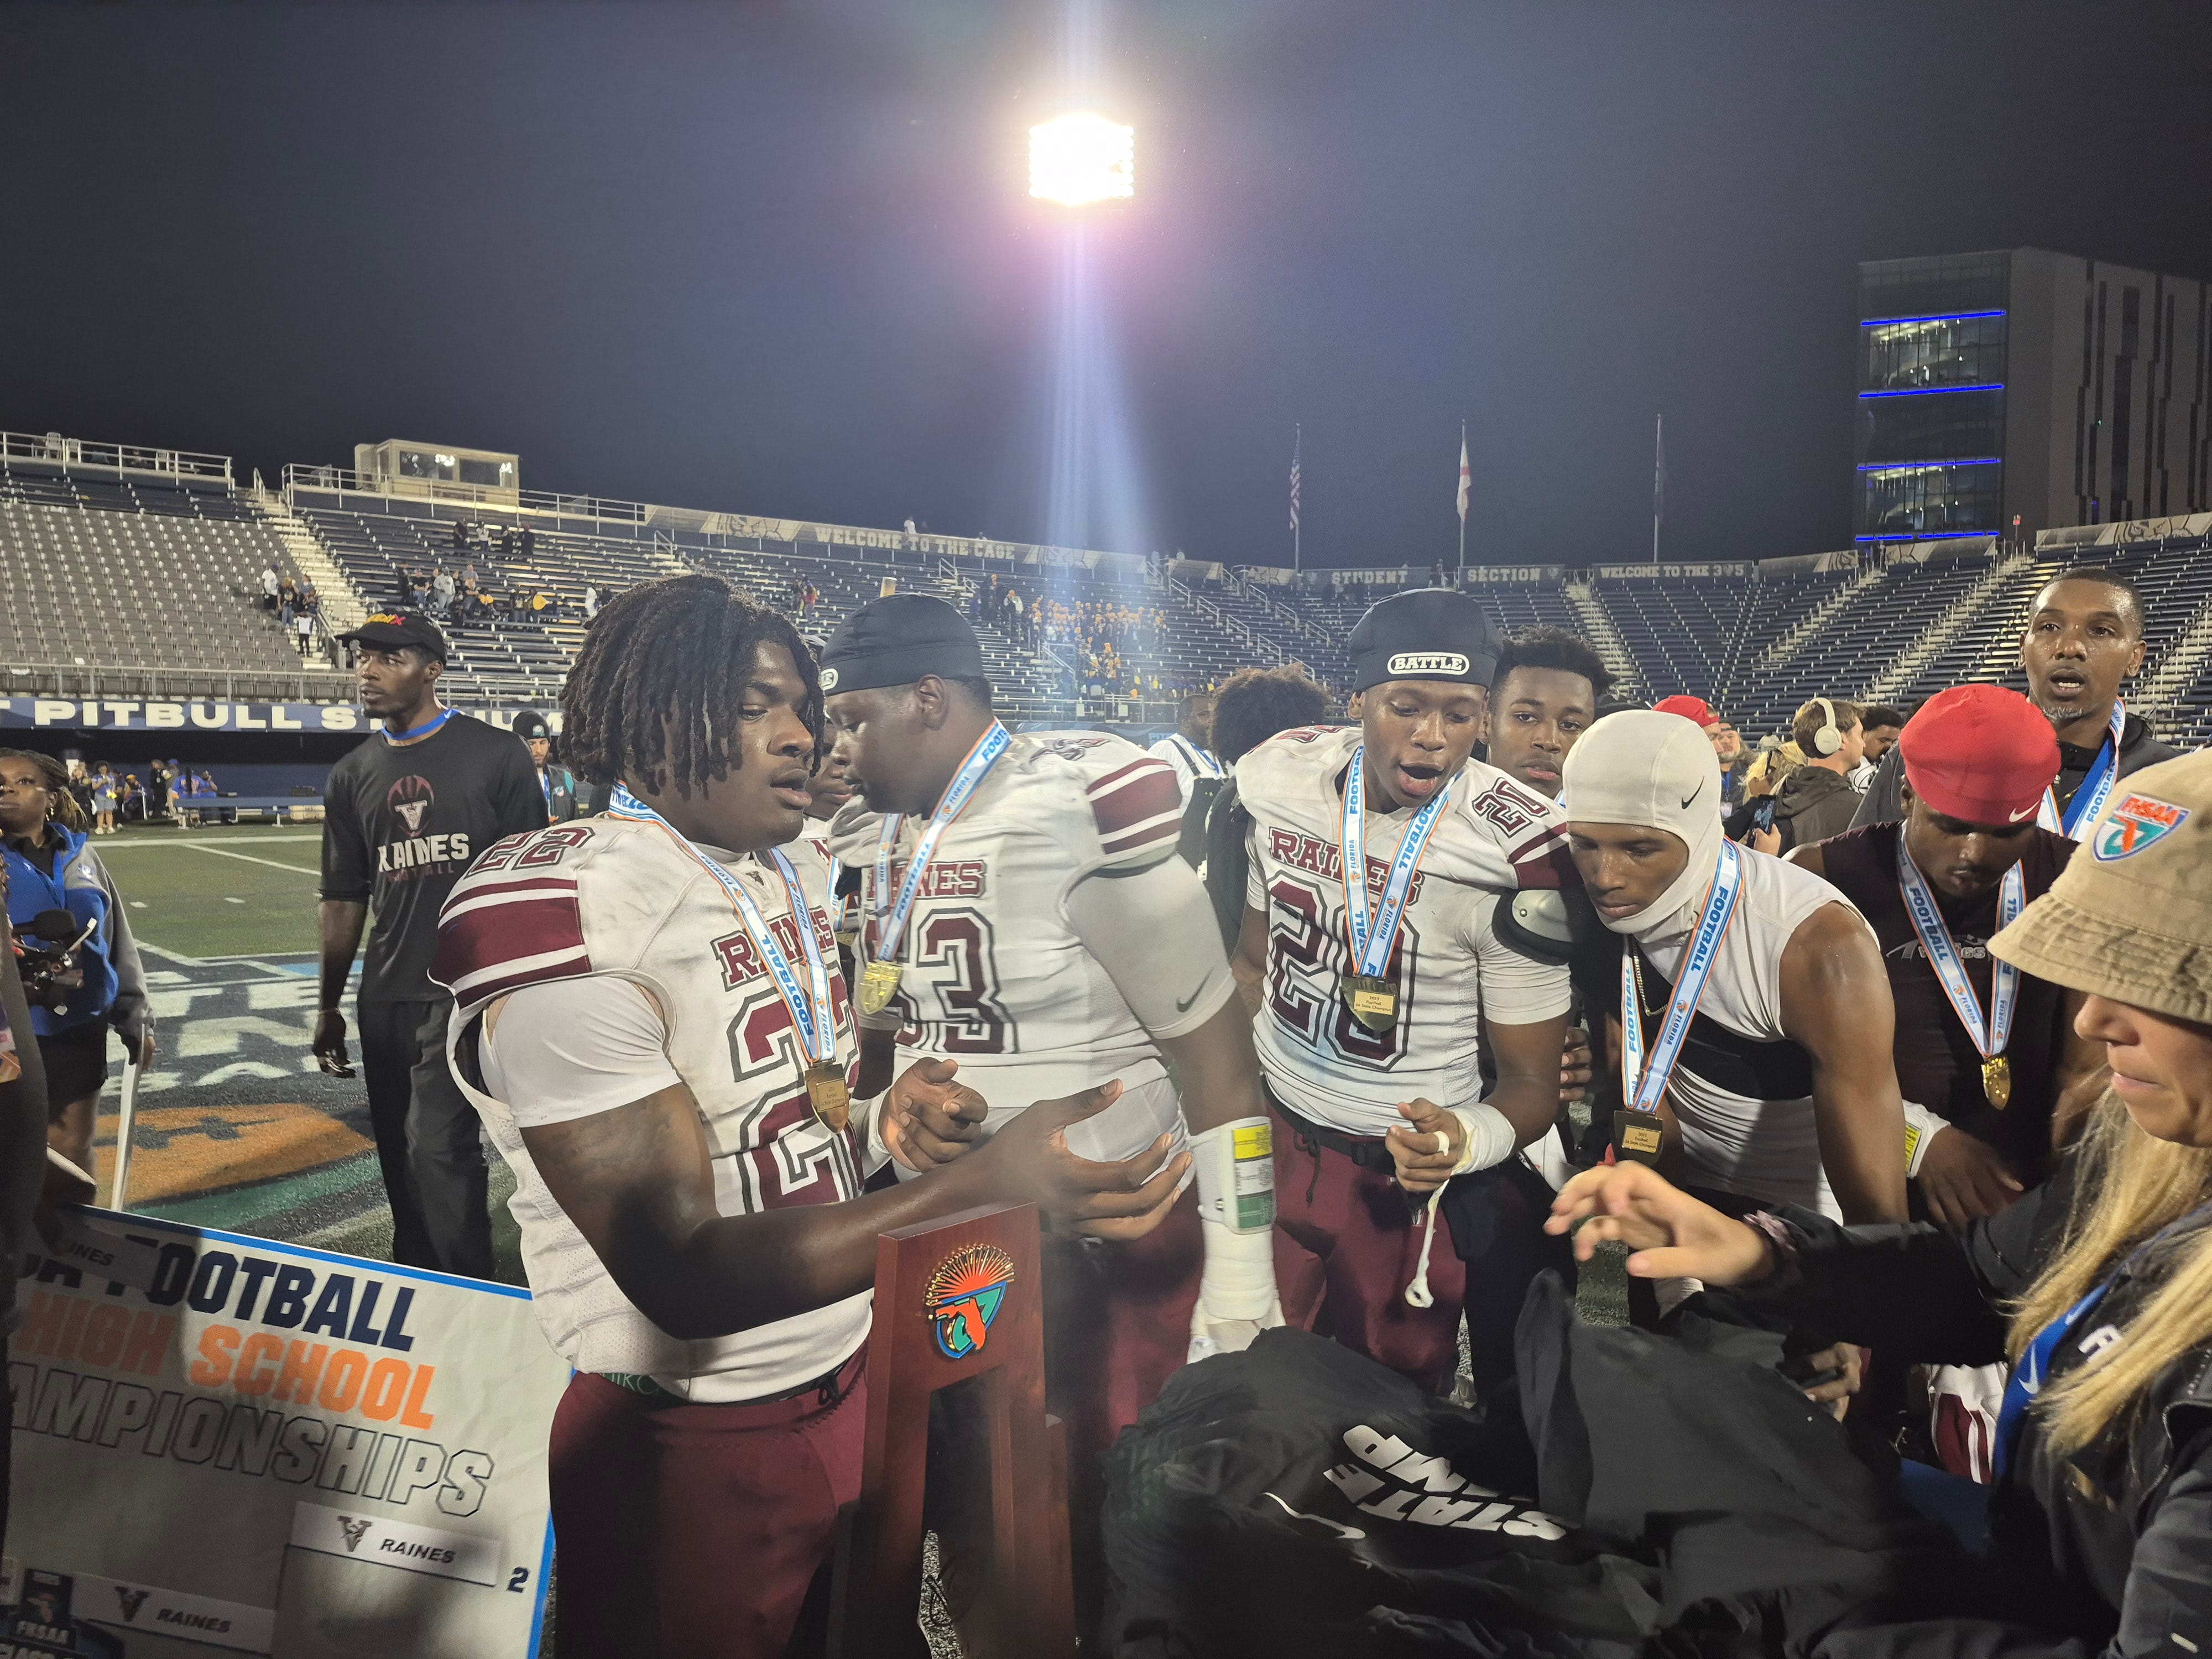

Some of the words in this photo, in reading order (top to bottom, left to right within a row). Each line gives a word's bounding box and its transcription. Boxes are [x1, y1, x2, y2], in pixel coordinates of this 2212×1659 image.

[816, 527, 902, 550] WELCOME
[909, 532, 930, 552] TO
[937, 538, 969, 556] THE
[974, 542, 1015, 560] CAGE
[1331, 570, 1408, 585] STUDENT
[1467, 566, 1541, 583] SECTION
[1600, 566, 1660, 578] WELCOME
[1663, 565, 1680, 577] TO
[1683, 565, 1709, 577] THE
[1394, 657, 1463, 672] BATTLE
[34, 700, 302, 729] PITBULL
[1472, 776, 1551, 838] 20
[377, 833, 470, 873] RAINES
[463, 826, 596, 880] 22
[795, 892, 809, 930] FLORIDA
[1379, 910, 1394, 941] FLORIDA
[1691, 885, 1729, 972] FOOTBALL
[1909, 887, 1948, 961] FOOTBALL
[760, 933, 814, 1036] FOOTBALL
[1267, 869, 1421, 1072] 20
[1625, 967, 1637, 1053] FOOTBALL
[1961, 997, 1978, 1025] FLORIDA
[1997, 1000, 2006, 1029] FLORIDA
[821, 1013, 831, 1052] FLORIDA
[1666, 1015, 1682, 1046] FLORIDA
[14, 1289, 177, 1376] HIGH
[189, 1323, 435, 1430] SCHOOL
[8, 1361, 495, 1517] AMPIONSHIPS
[1323, 1463, 1567, 1541] STATE
[379, 1538, 456, 1564] RAINES
[506, 1567, 530, 1593] 2
[157, 1608, 232, 1634] RAINES
